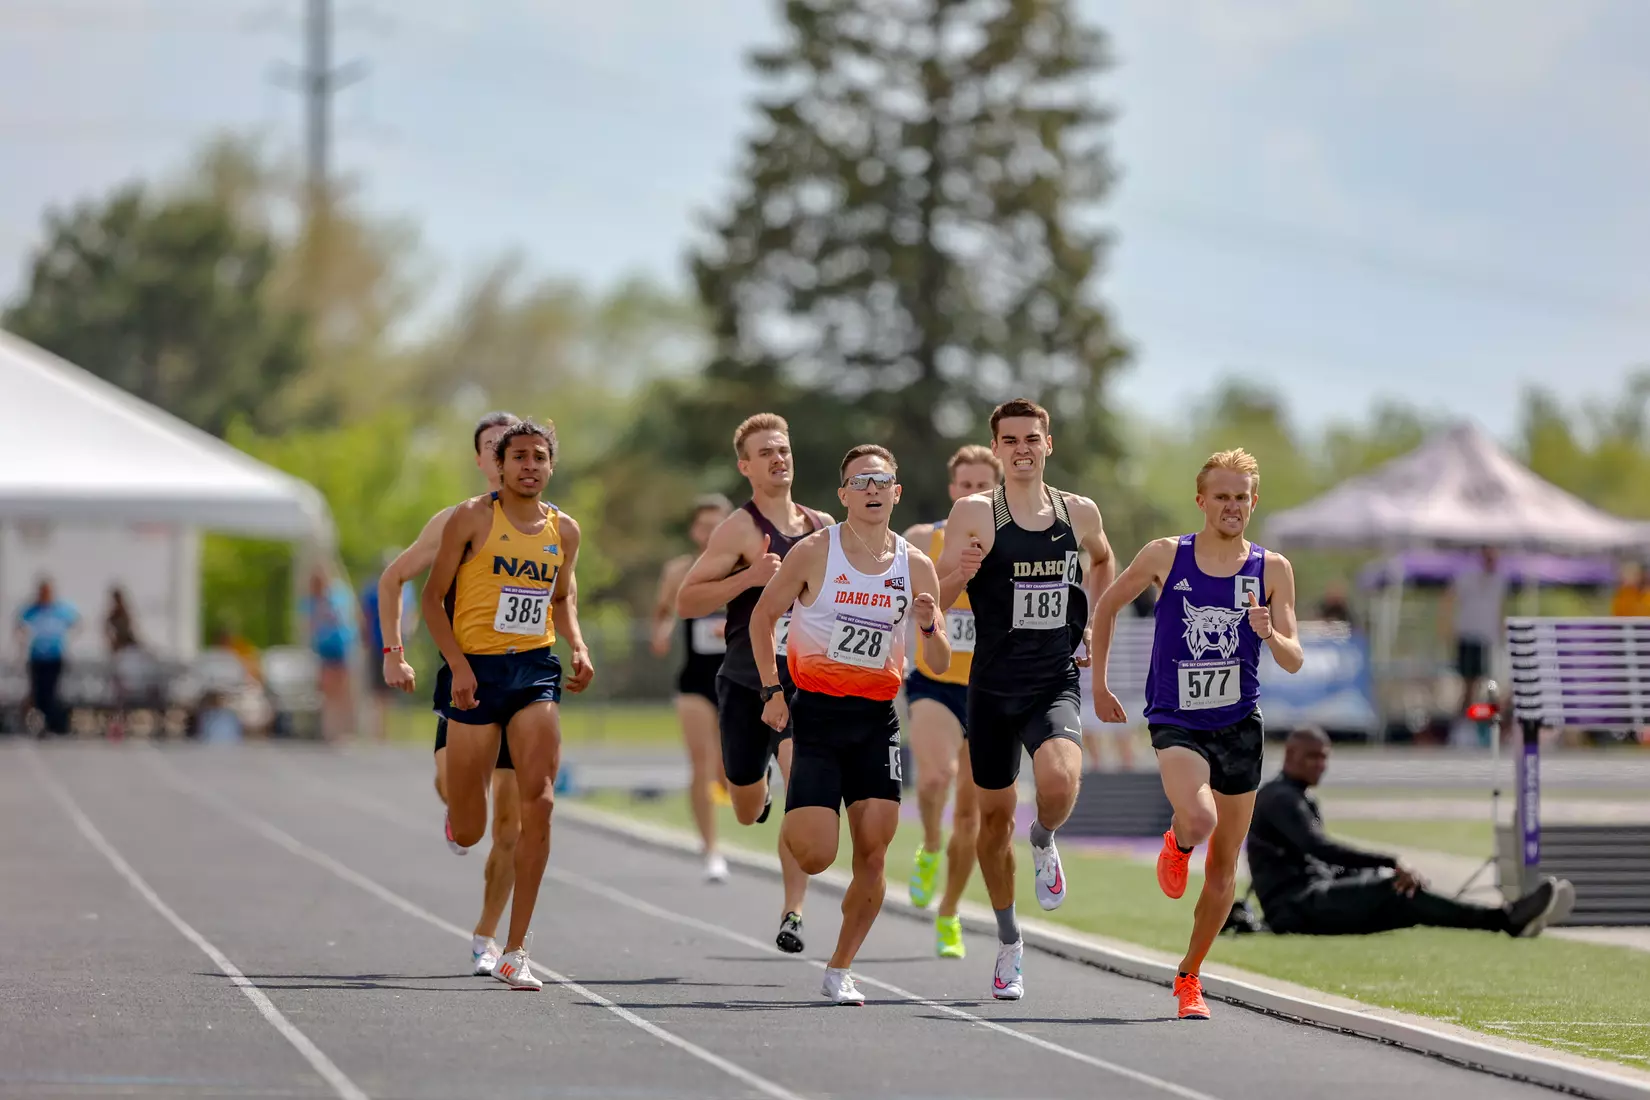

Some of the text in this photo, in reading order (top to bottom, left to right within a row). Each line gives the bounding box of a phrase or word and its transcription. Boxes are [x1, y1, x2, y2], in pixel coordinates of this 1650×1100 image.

[493, 556, 558, 583] NAU
[892, 577, 904, 586] SKY
[1013, 560, 1066, 577] IDAHO
[1067, 553, 1076, 582] 6
[835, 591, 891, 608] IDAHO STA
[1023, 591, 1061, 618] 183
[1241, 578, 1255, 607] 5
[505, 596, 543, 624] 385
[893, 595, 908, 625] 3
[838, 625, 883, 658] 228
[1188, 669, 1230, 698] 577
